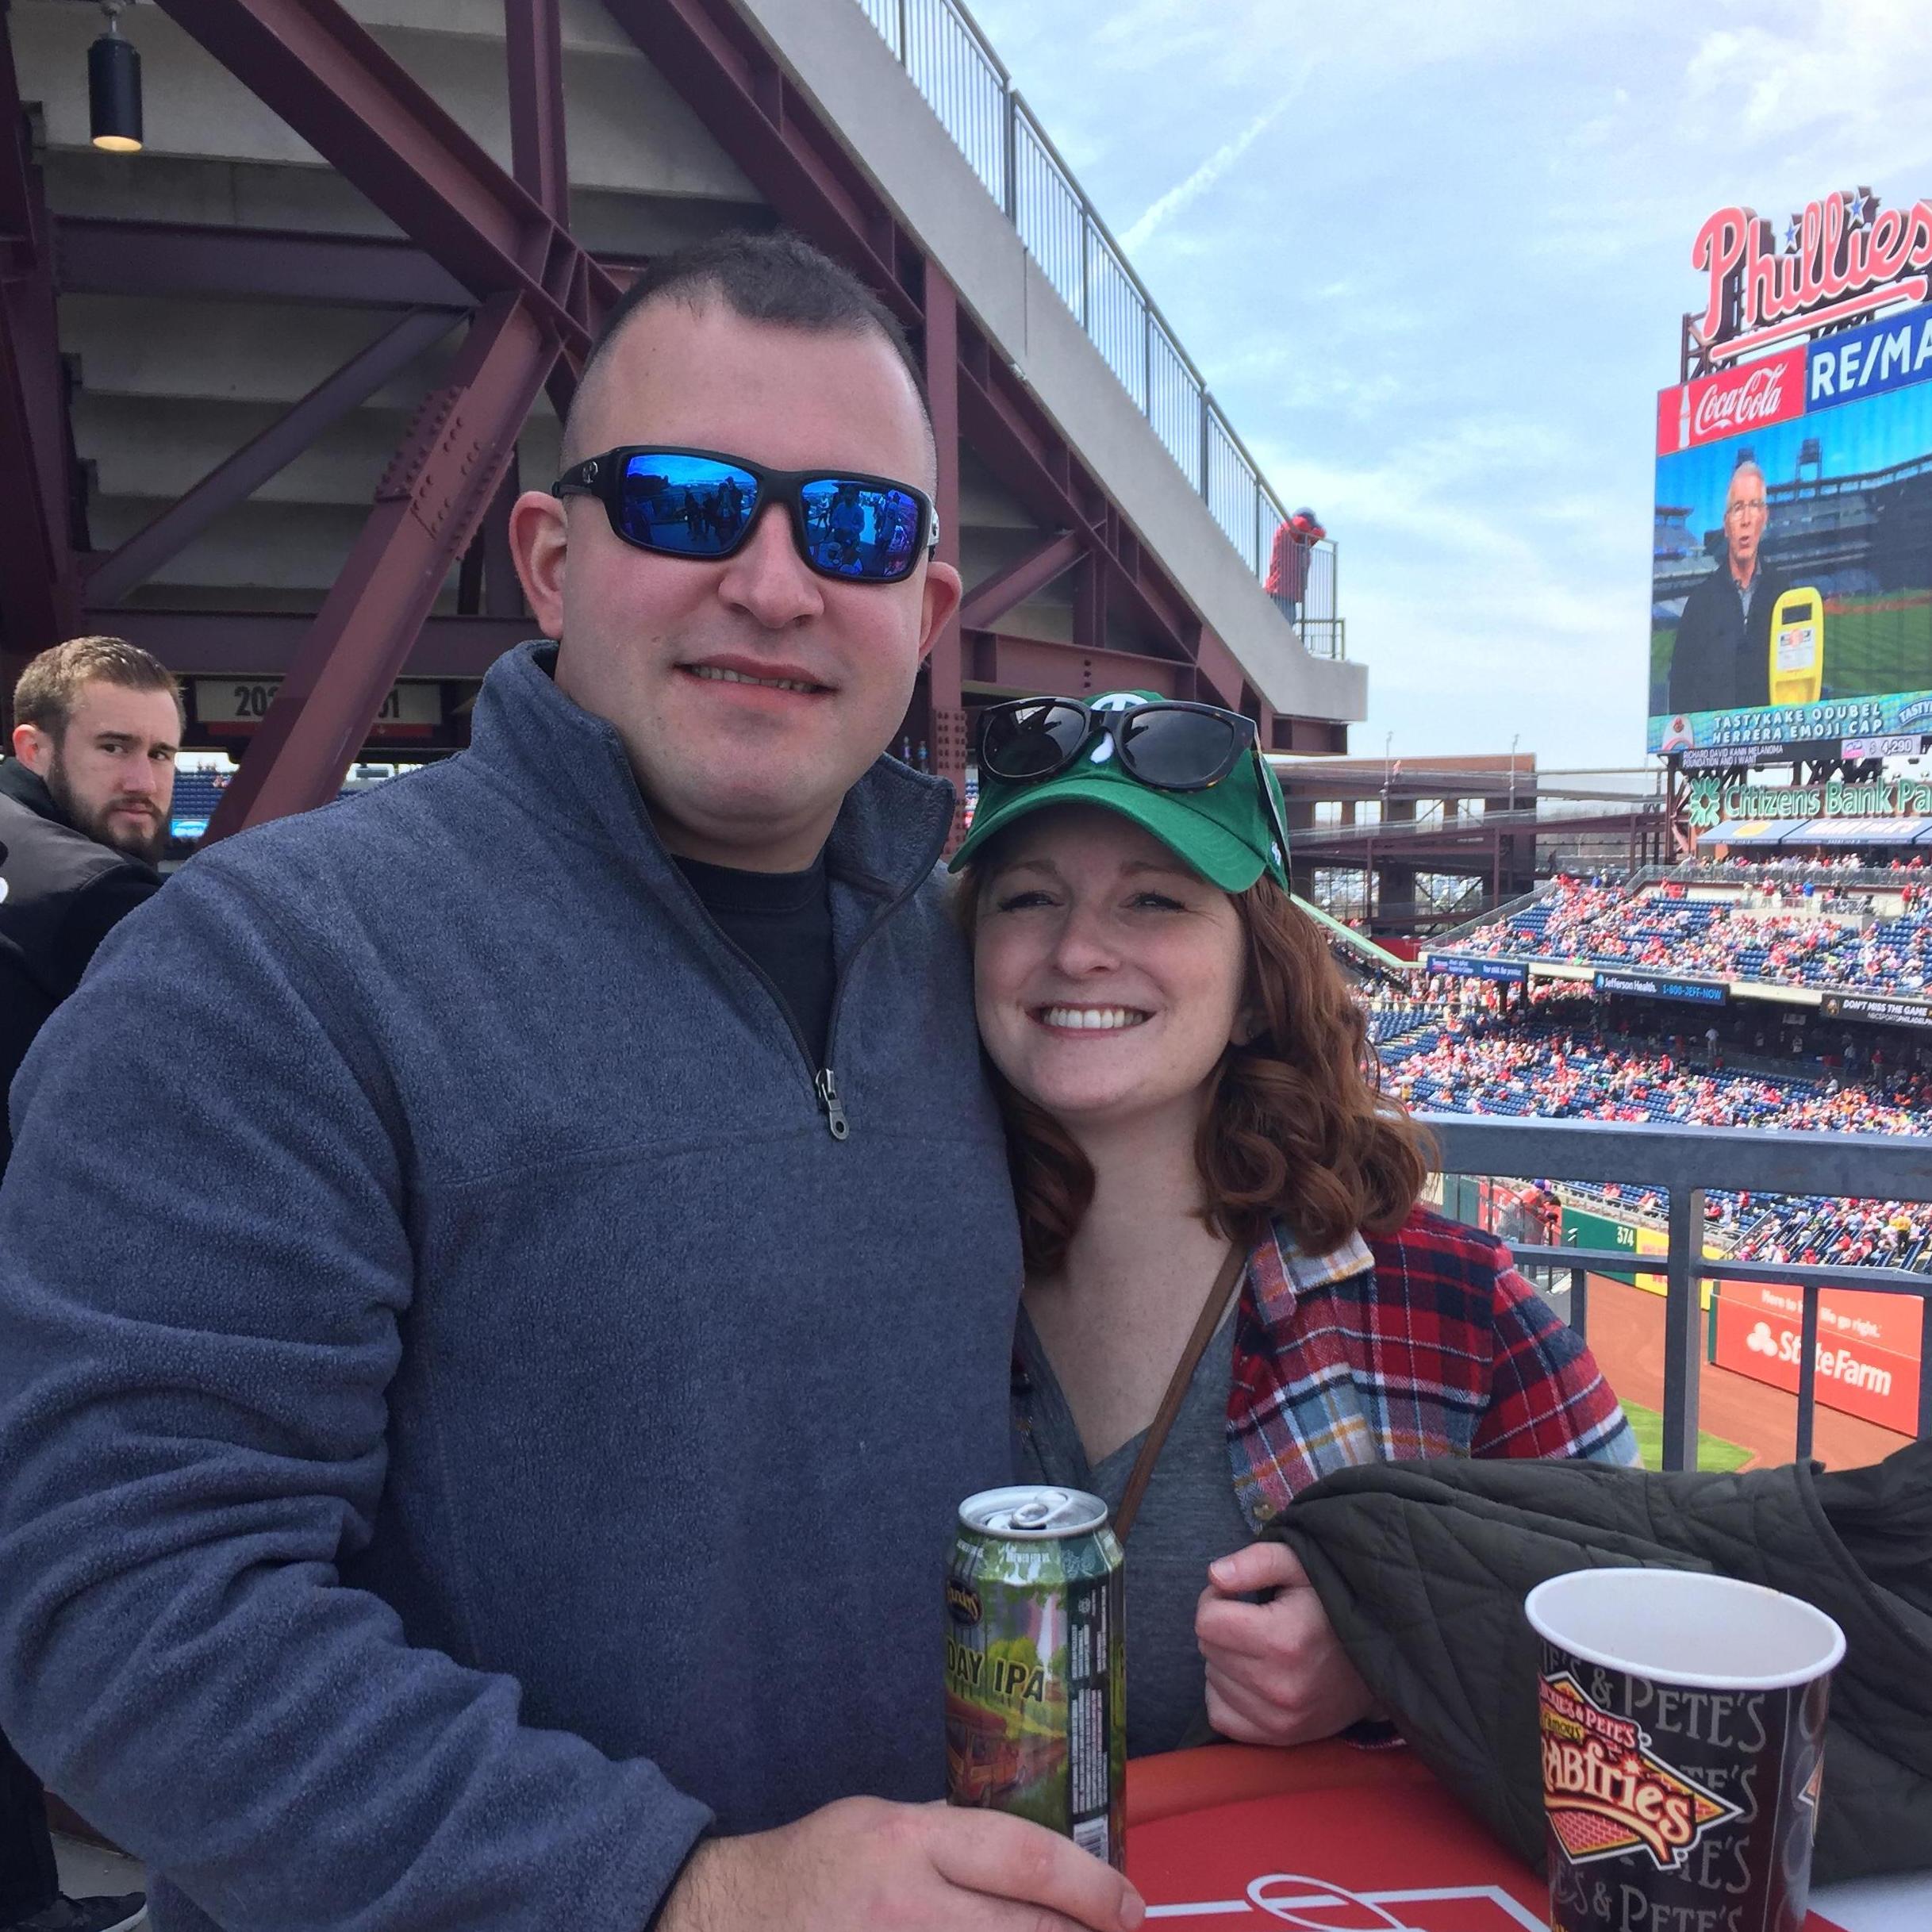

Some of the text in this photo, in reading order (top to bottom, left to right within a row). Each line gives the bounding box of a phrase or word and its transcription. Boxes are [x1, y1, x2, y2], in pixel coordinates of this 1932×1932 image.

[1692, 190, 1932, 340] Phillies
[1714, 703, 1880, 729] TASTYKAKE ODUBEL
[1712, 718, 1883, 745] HERRERA EMOJI CAP
[1683, 750, 1709, 759] RICHARD
[1710, 749, 1728, 759] DAVID
[1748, 745, 1784, 755] MELANOMA
[1683, 756, 1719, 768] FOUNDATION
[1720, 756, 1734, 766] AND
[1738, 755, 1757, 765] WANT
[1724, 782, 1821, 817] Citizens
[1826, 777, 1893, 815] Bank
[1604, 977, 1634, 989] Jefferson
[1842, 1000, 1928, 1016] DON'T MISS THE GAME
[1616, 1226, 1634, 1246] 374
[1761, 1289, 1784, 1308] Here
[1785, 1298, 1797, 1312] to
[994, 1657, 1045, 1702] IPA
[1591, 1667, 1614, 1708] &
[1625, 1673, 1766, 1753] PETE'S
[1585, 1707, 1635, 1749] PETE'S
